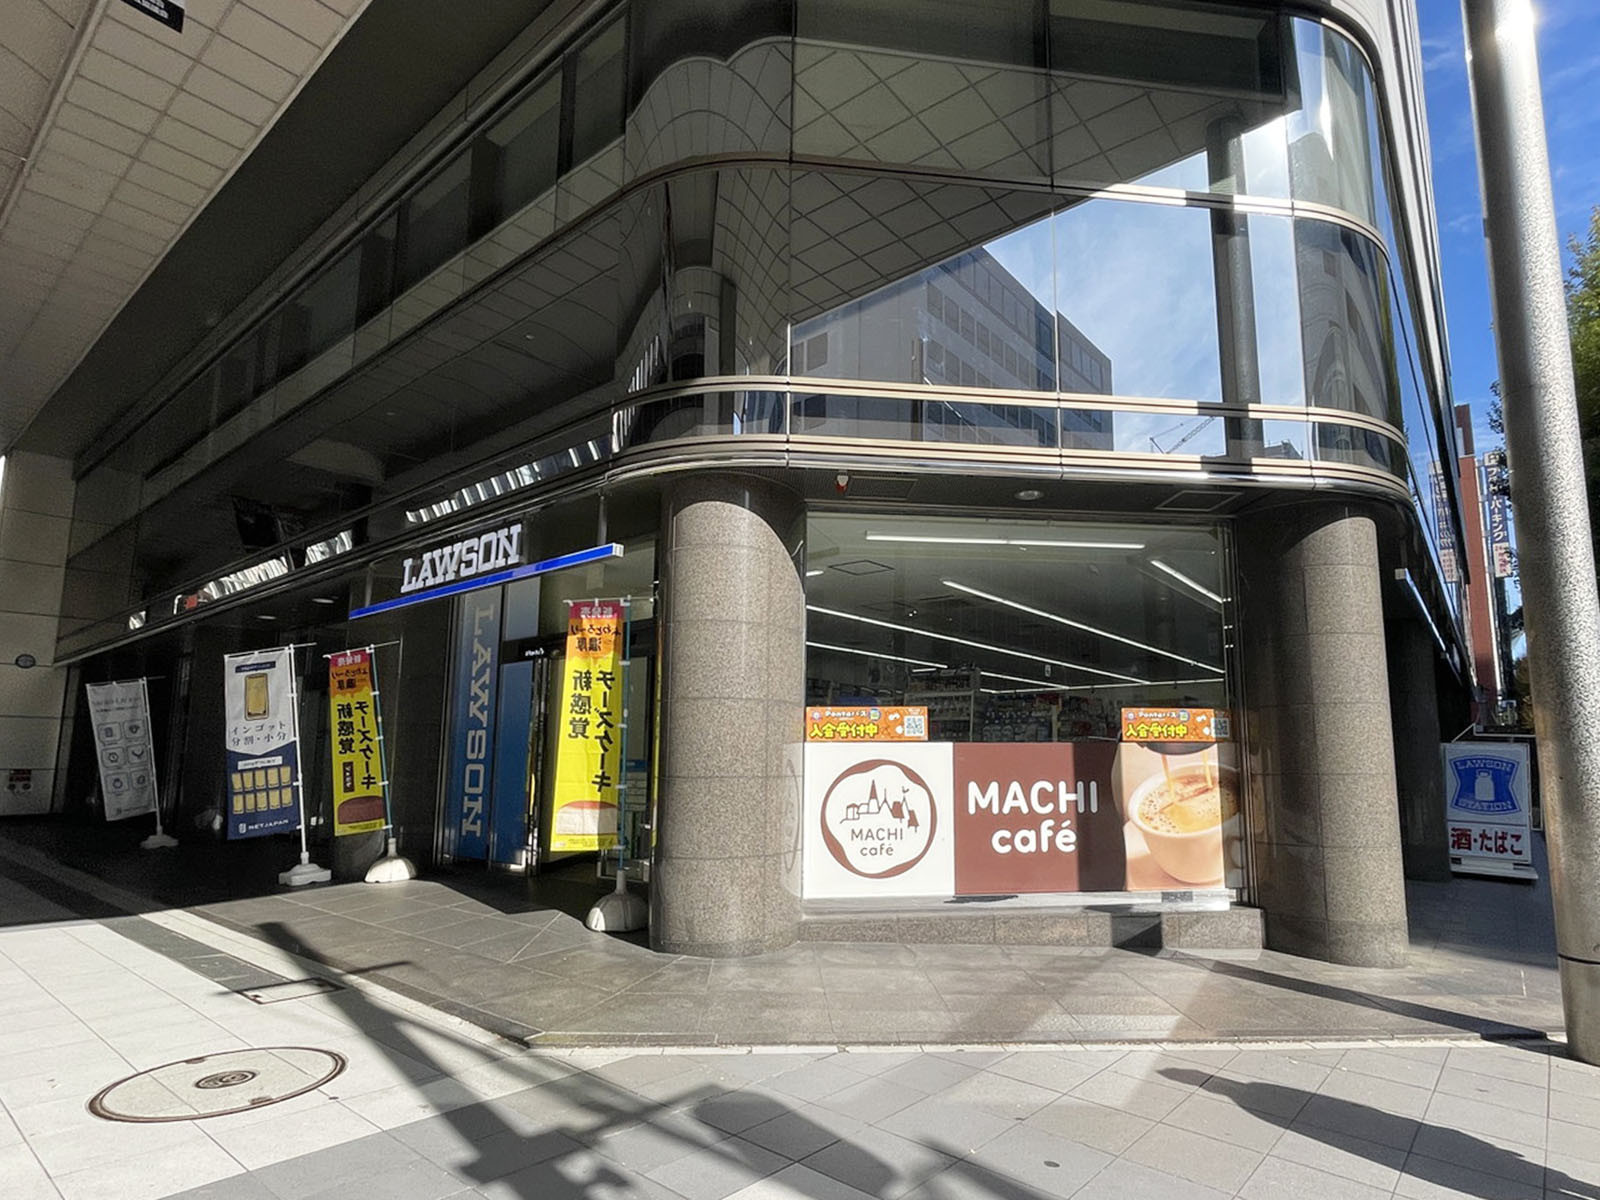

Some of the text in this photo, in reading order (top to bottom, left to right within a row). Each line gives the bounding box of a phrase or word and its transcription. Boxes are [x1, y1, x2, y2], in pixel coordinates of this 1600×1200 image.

[400, 523, 522, 593] LAWSON
[232, 720, 286, 736] インゴット
[461, 604, 495, 838] LAWSON
[809, 722, 879, 739] 入会受付中
[1126, 722, 1189, 739] 入会受付中
[1456, 759, 1513, 773] LAWSON
[968, 780, 1098, 815] MACHI
[1457, 799, 1513, 811] STATION
[851, 828, 904, 841] MACHI
[991, 819, 1078, 854] café
[1450, 827, 1523, 856] 酒・たばこ
[860, 843, 894, 857] café
